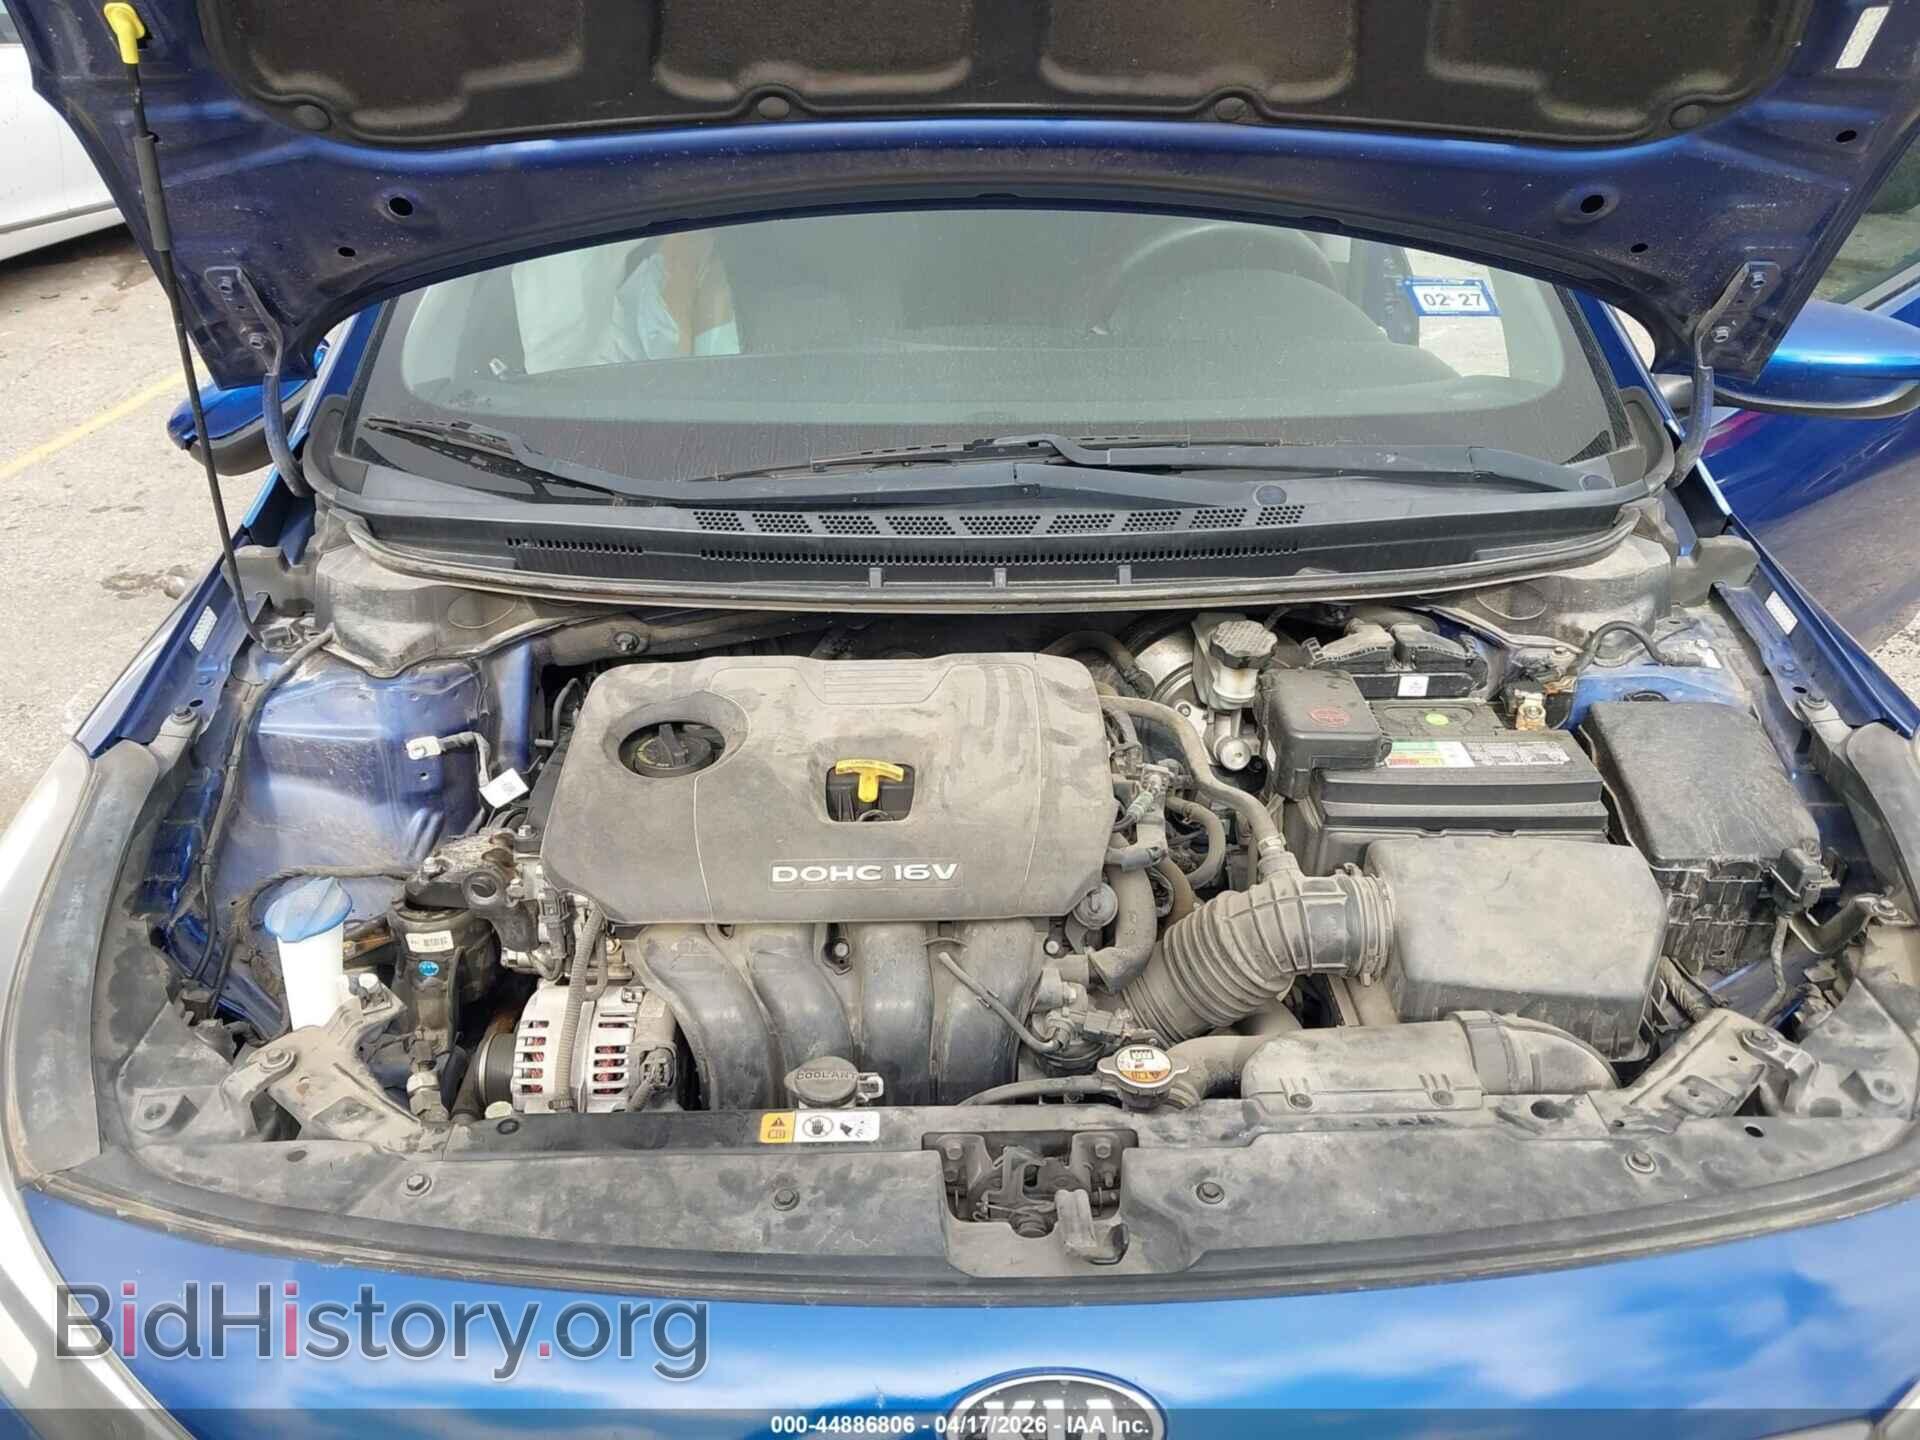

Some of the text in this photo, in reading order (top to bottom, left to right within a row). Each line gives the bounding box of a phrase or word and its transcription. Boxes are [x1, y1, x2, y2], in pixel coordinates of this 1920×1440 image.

[1423, 293, 1481, 307] 02 27
[772, 863, 958, 882] DOHC 16V
[796, 1071, 858, 1081] COOLANT
